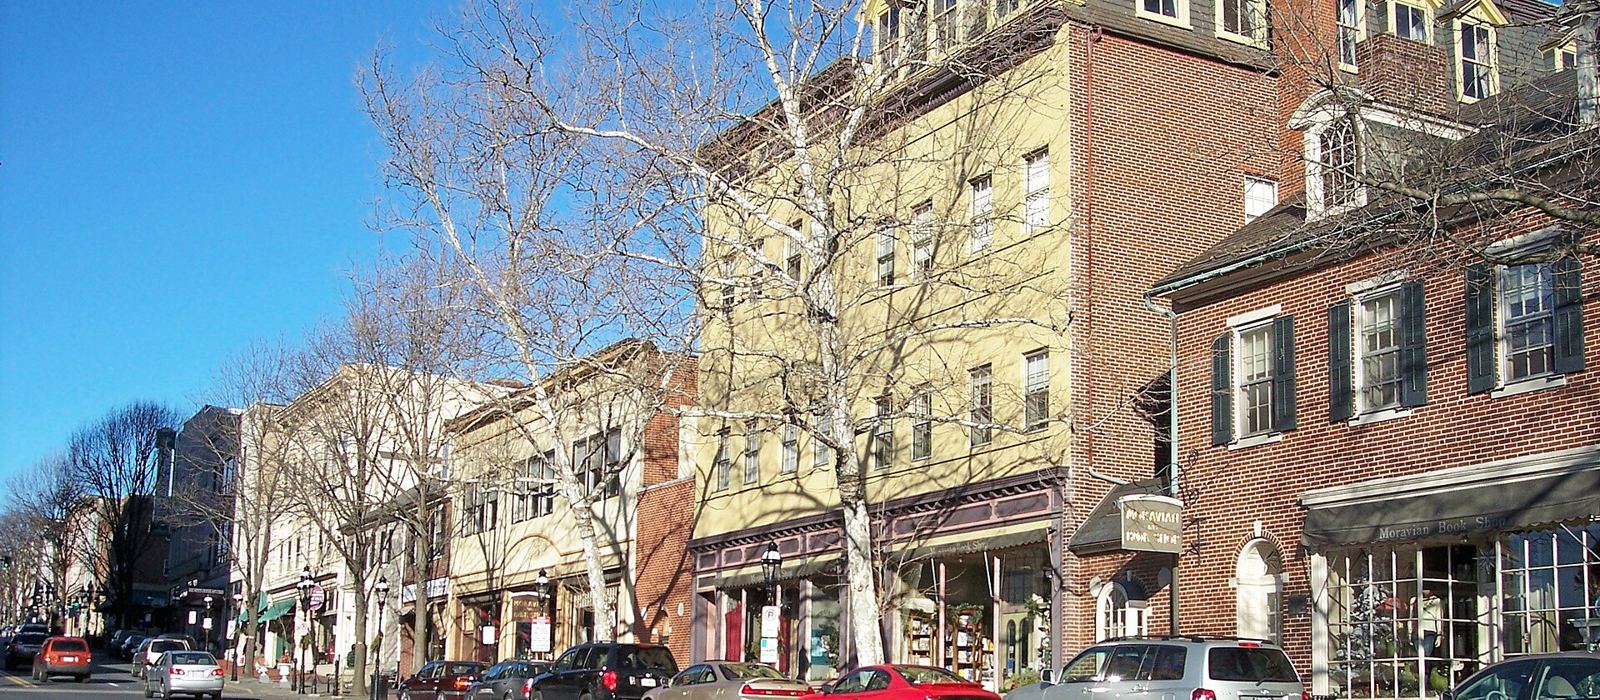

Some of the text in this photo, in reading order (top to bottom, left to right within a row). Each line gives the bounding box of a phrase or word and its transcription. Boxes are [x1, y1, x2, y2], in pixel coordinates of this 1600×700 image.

[1378, 515, 1505, 540] Moravian Book Shop
